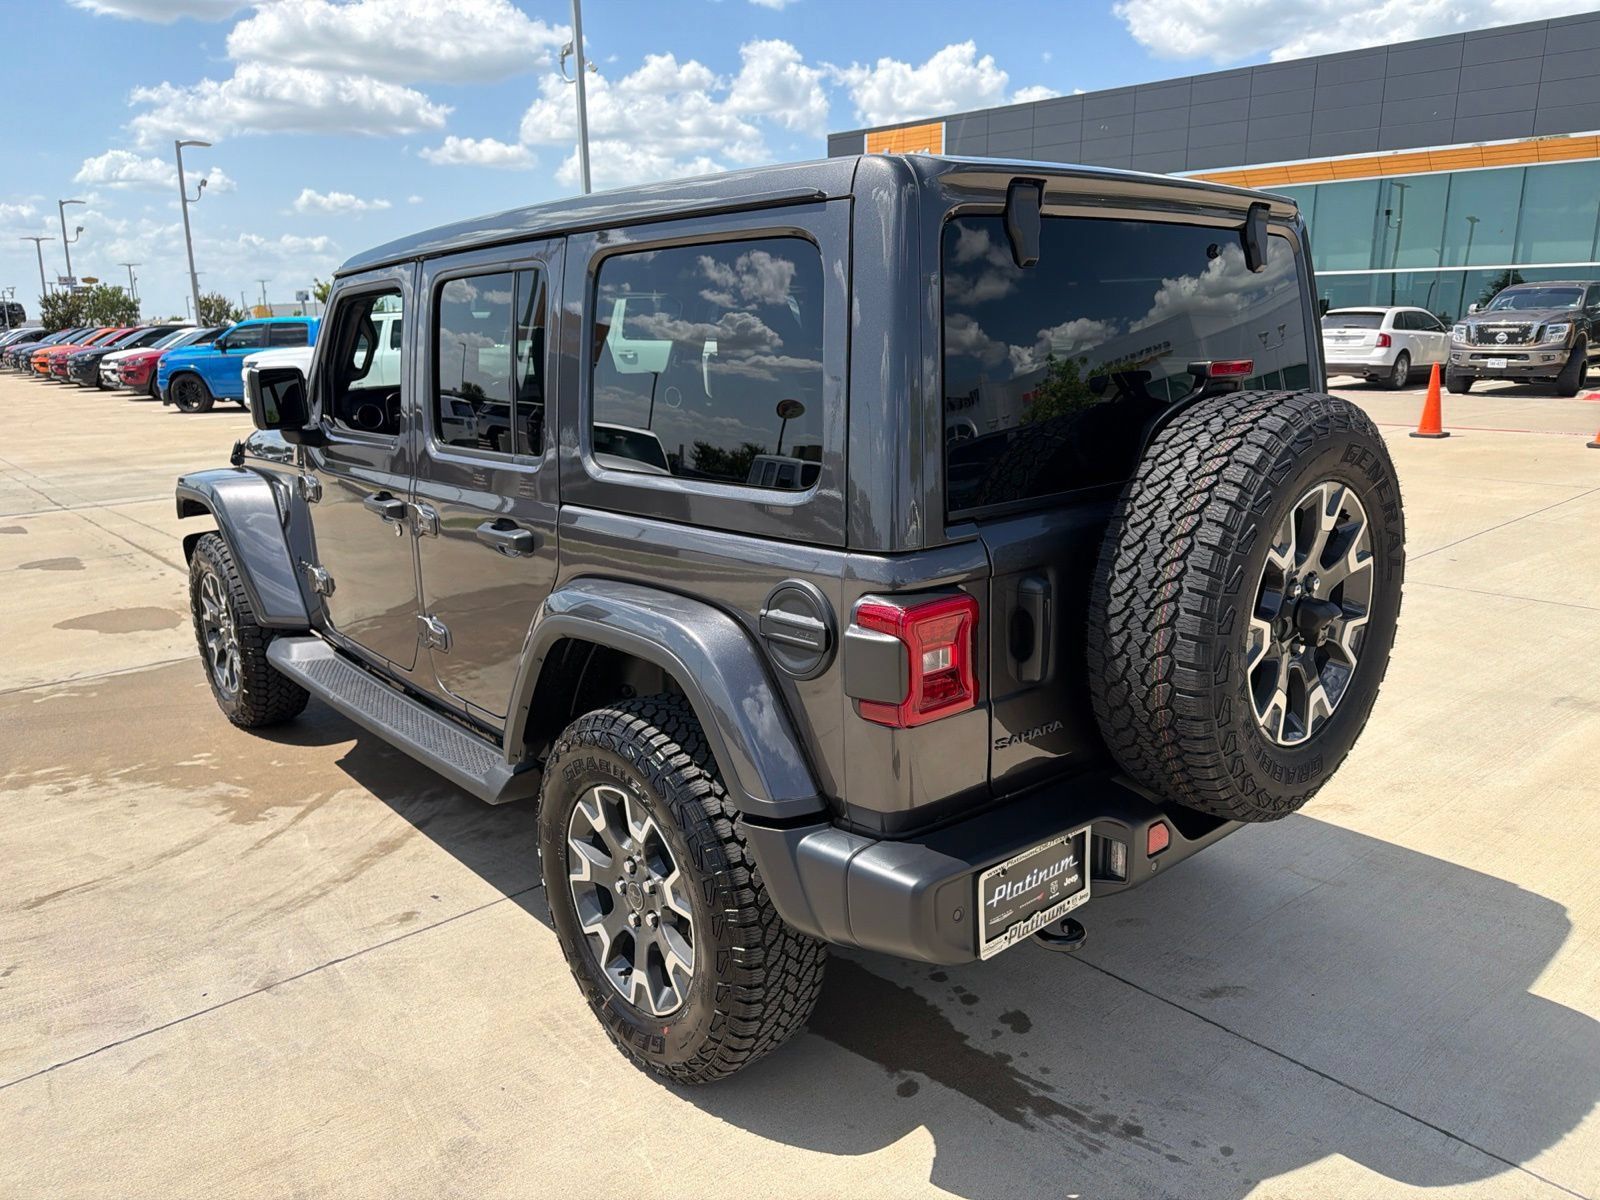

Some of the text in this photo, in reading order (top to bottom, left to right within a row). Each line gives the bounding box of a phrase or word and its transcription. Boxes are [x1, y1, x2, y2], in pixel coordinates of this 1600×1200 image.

[1341, 441, 1402, 582] GENERAL
[993, 719, 1064, 751] SAHARA
[986, 854, 1079, 908] Platinum
[1063, 873, 1079, 888] Jeep
[1008, 902, 1070, 944] Platinum
